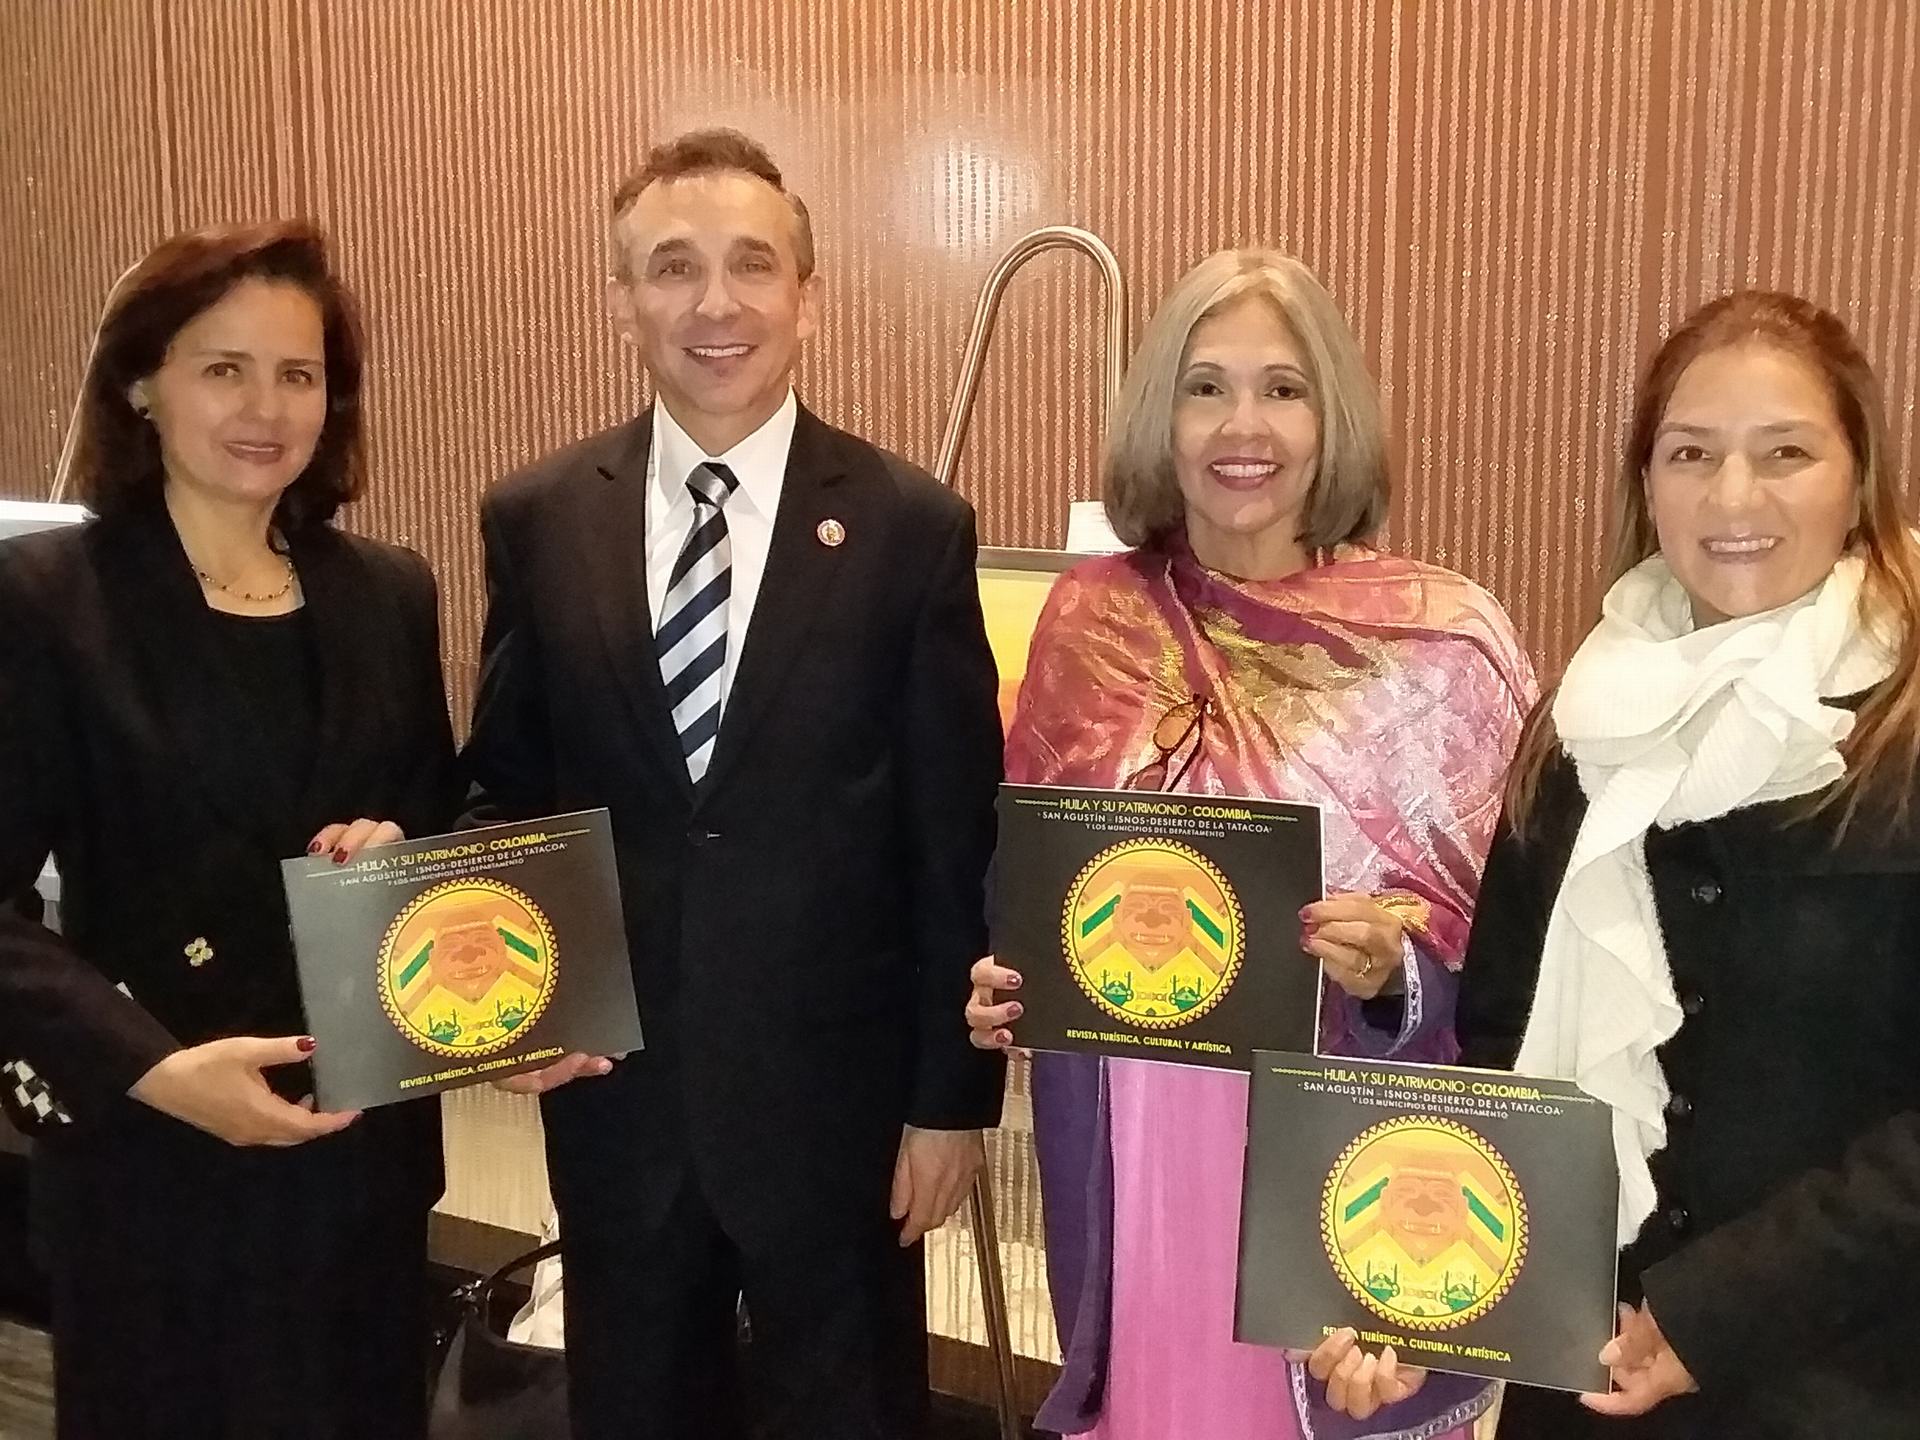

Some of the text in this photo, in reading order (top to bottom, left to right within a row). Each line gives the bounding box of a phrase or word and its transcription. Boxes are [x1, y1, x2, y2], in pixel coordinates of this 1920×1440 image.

[1059, 798, 1252, 820] HUILA Y SU PATRIMONIO COLOMBIA
[1042, 811, 1061, 820] SAN
[1198, 820, 1210, 829] DE
[1213, 821, 1225, 830] LA
[356, 832, 548, 873] HUILA Y SU PATRIMONIO COLOMBIA
[497, 851, 509, 860] DE
[511, 849, 523, 858] LA
[1066, 1029, 1098, 1041] REVISTA
[1143, 1036, 1183, 1049] CULTURAL
[1184, 1040, 1190, 1049] Y
[399, 1075, 433, 1090] REVISTA
[477, 1057, 517, 1073] CULTURAL
[517, 1055, 524, 1063] Y
[1323, 1067, 1541, 1101] HUILA Y SU PATRIMONIO COLOMBIA
[1303, 1081, 1324, 1092] SAN
[1477, 1098, 1492, 1109] DE
[1495, 1100, 1508, 1110] LA
[1409, 1338, 1455, 1354] CULTURAL
[1456, 1345, 1463, 1355] Y
